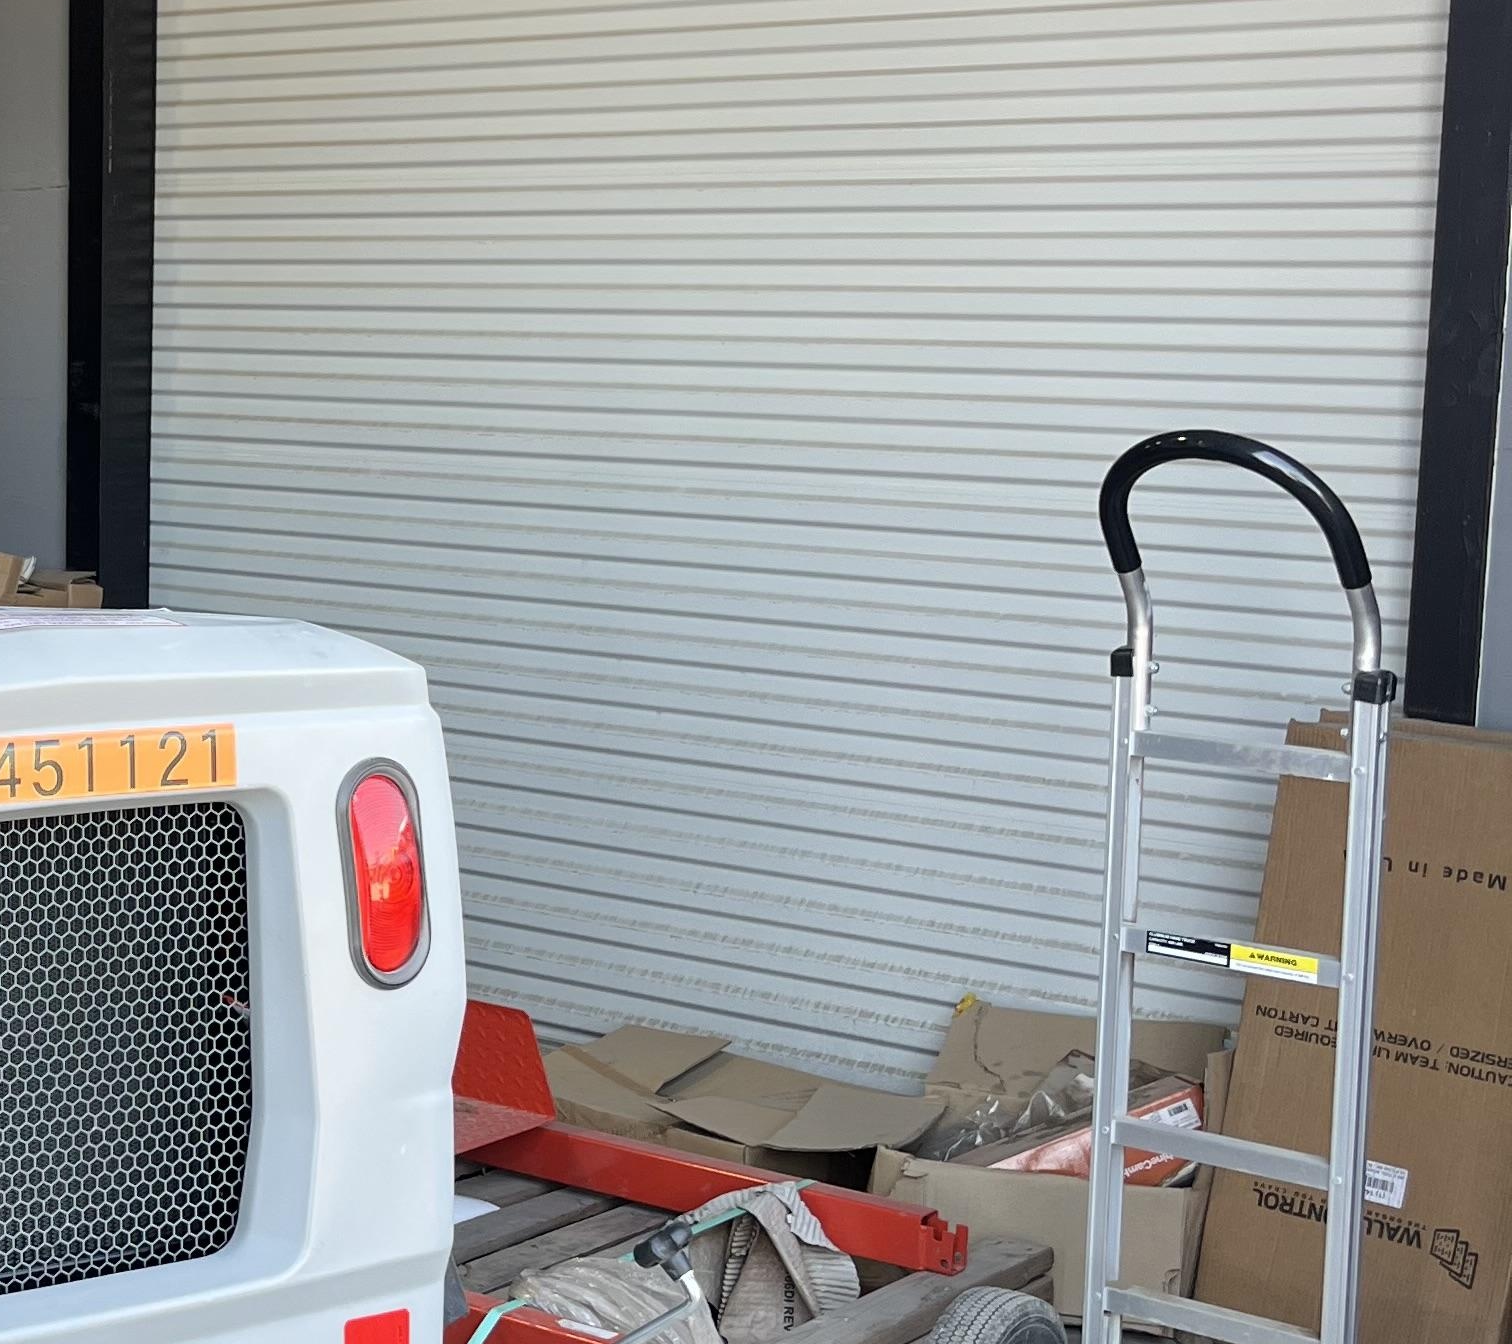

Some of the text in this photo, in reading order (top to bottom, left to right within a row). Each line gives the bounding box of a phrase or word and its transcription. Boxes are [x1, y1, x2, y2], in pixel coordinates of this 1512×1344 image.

[1408, 859, 1427, 878] in
[1442, 864, 1507, 892] Made
[1257, 952, 1298, 967] WARNING
[1255, 1003, 1321, 1029] CARTON
[1273, 1024, 1338, 1049] EQUIRED
[1395, 1049, 1440, 1072] TEAM
[1364, 1213, 1423, 1250] WALL
